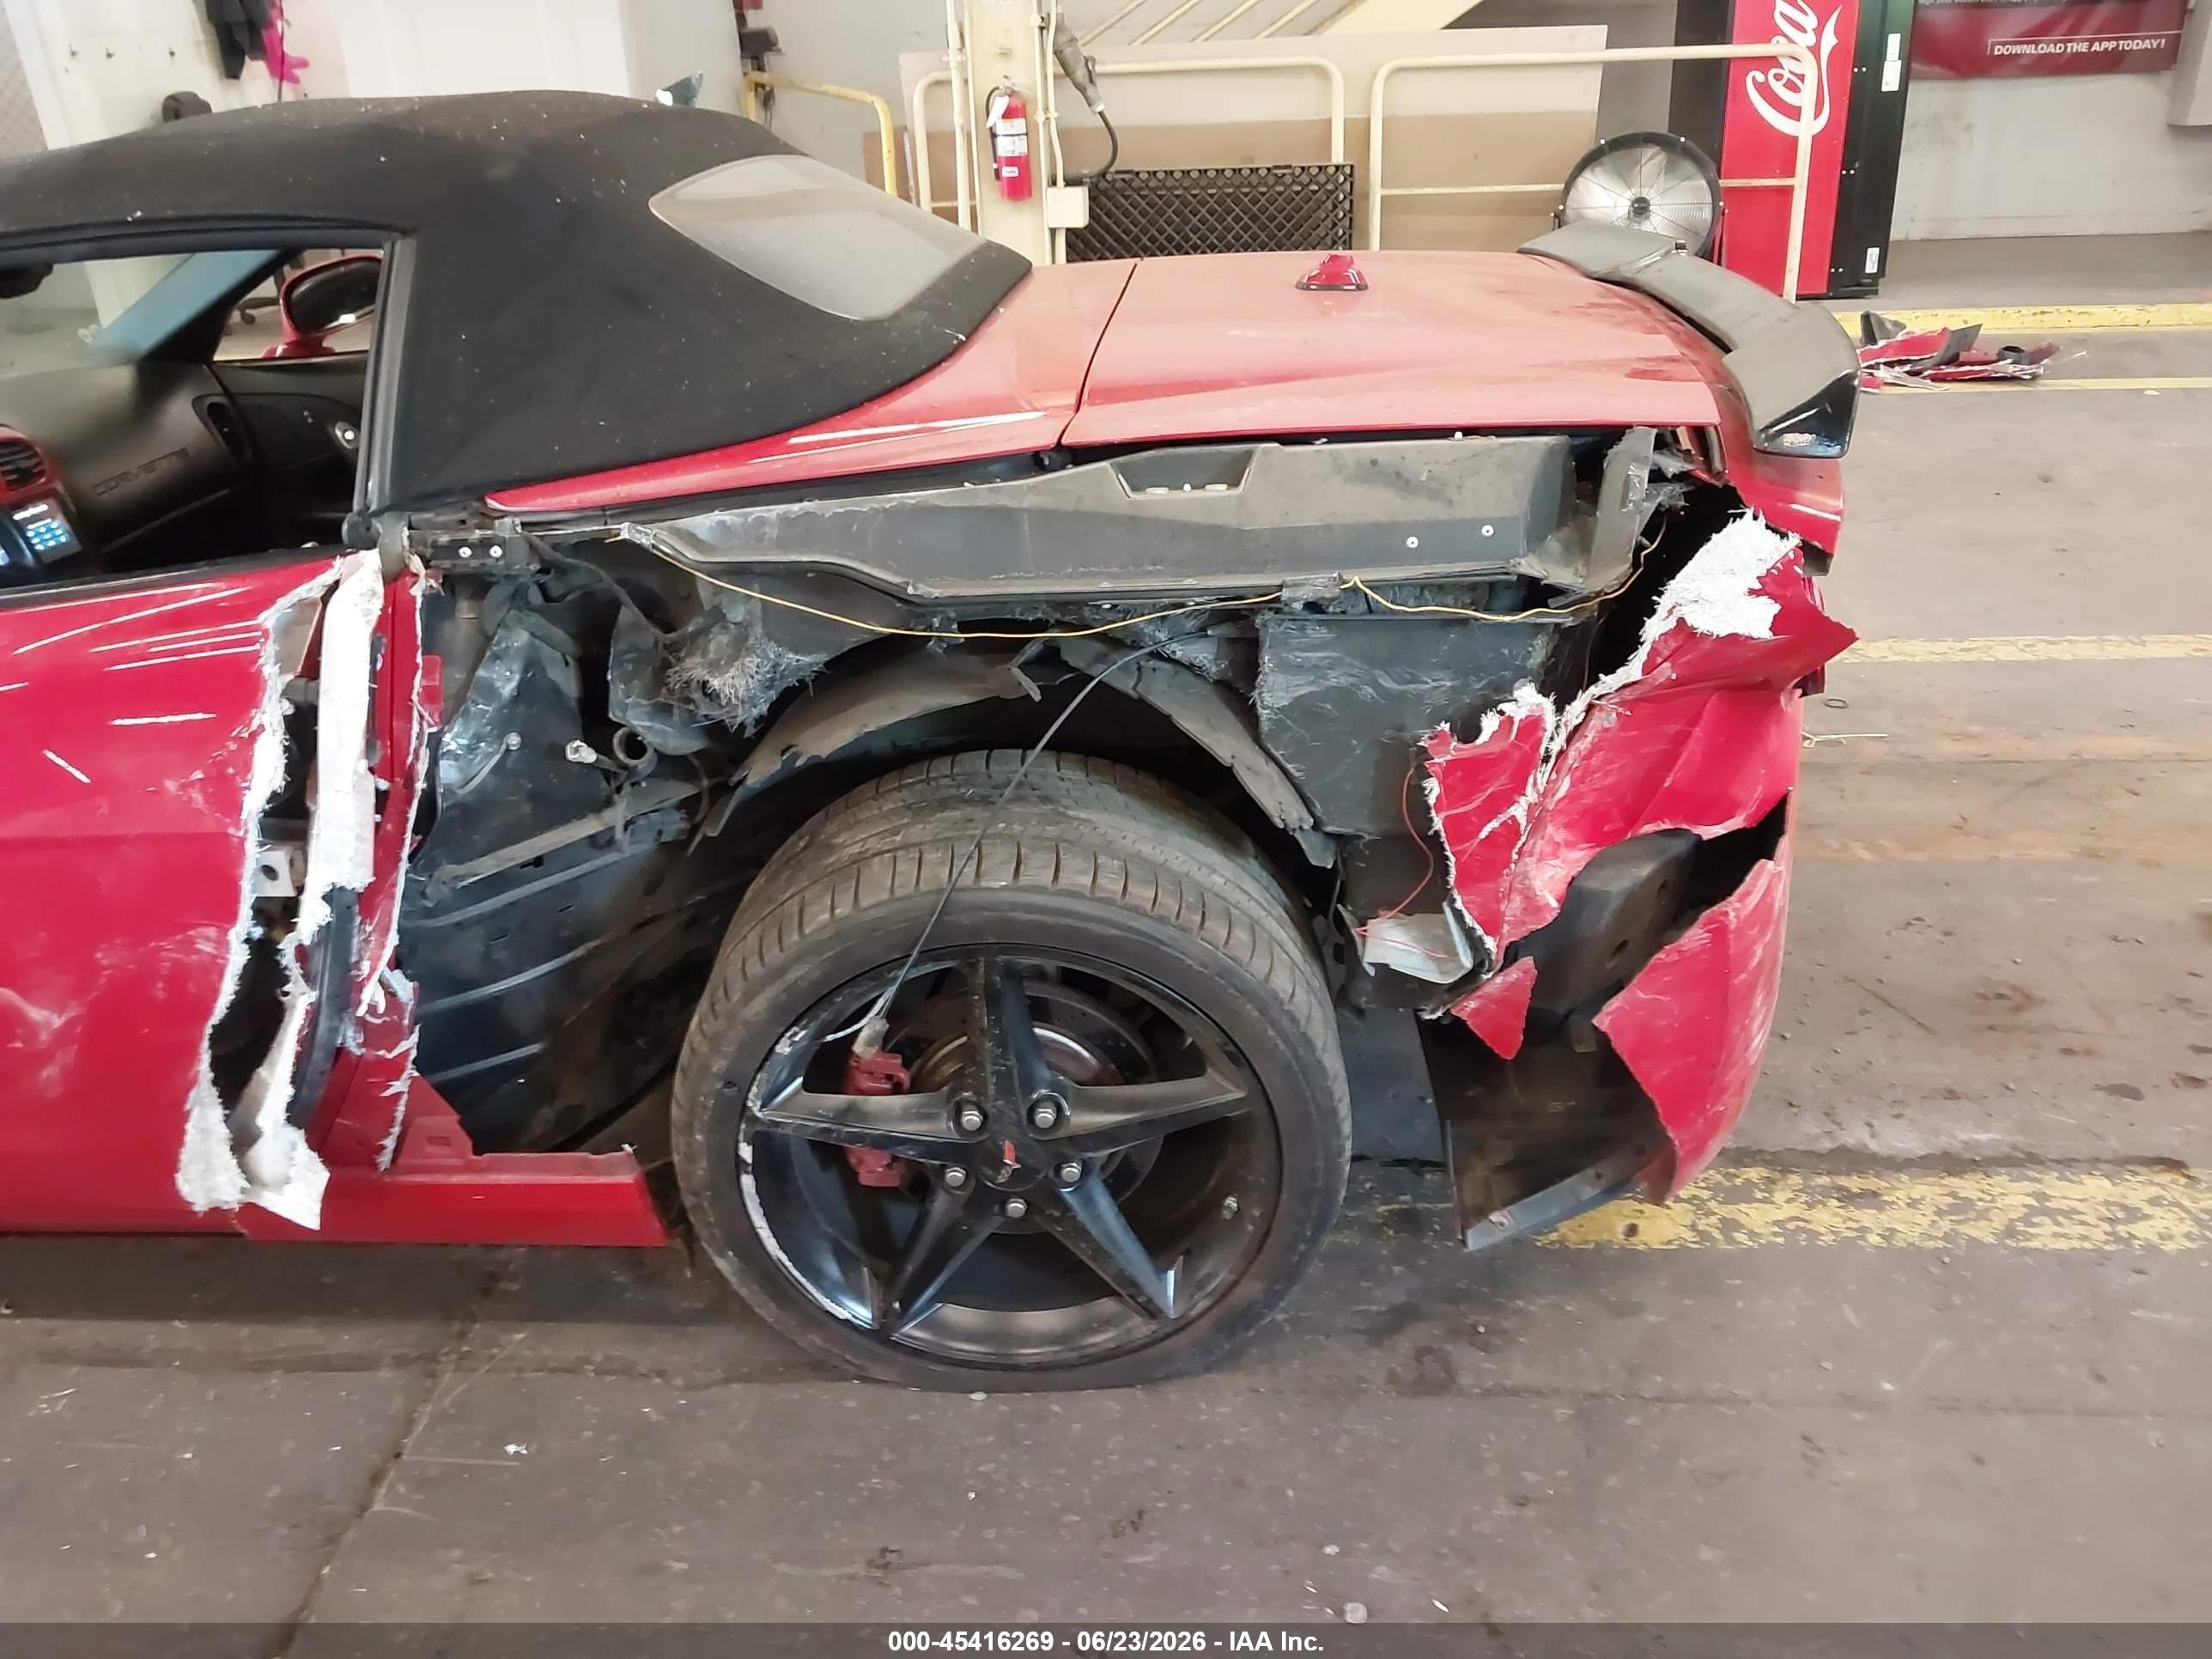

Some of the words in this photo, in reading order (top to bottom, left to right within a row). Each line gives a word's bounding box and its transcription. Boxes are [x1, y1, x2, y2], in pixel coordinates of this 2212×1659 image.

[1994, 42, 2067, 55] DOWNLOAD
[2067, 41, 2089, 52] THE
[2091, 40, 2118, 52] APP
[2118, 38, 2166, 50] TODAY!
